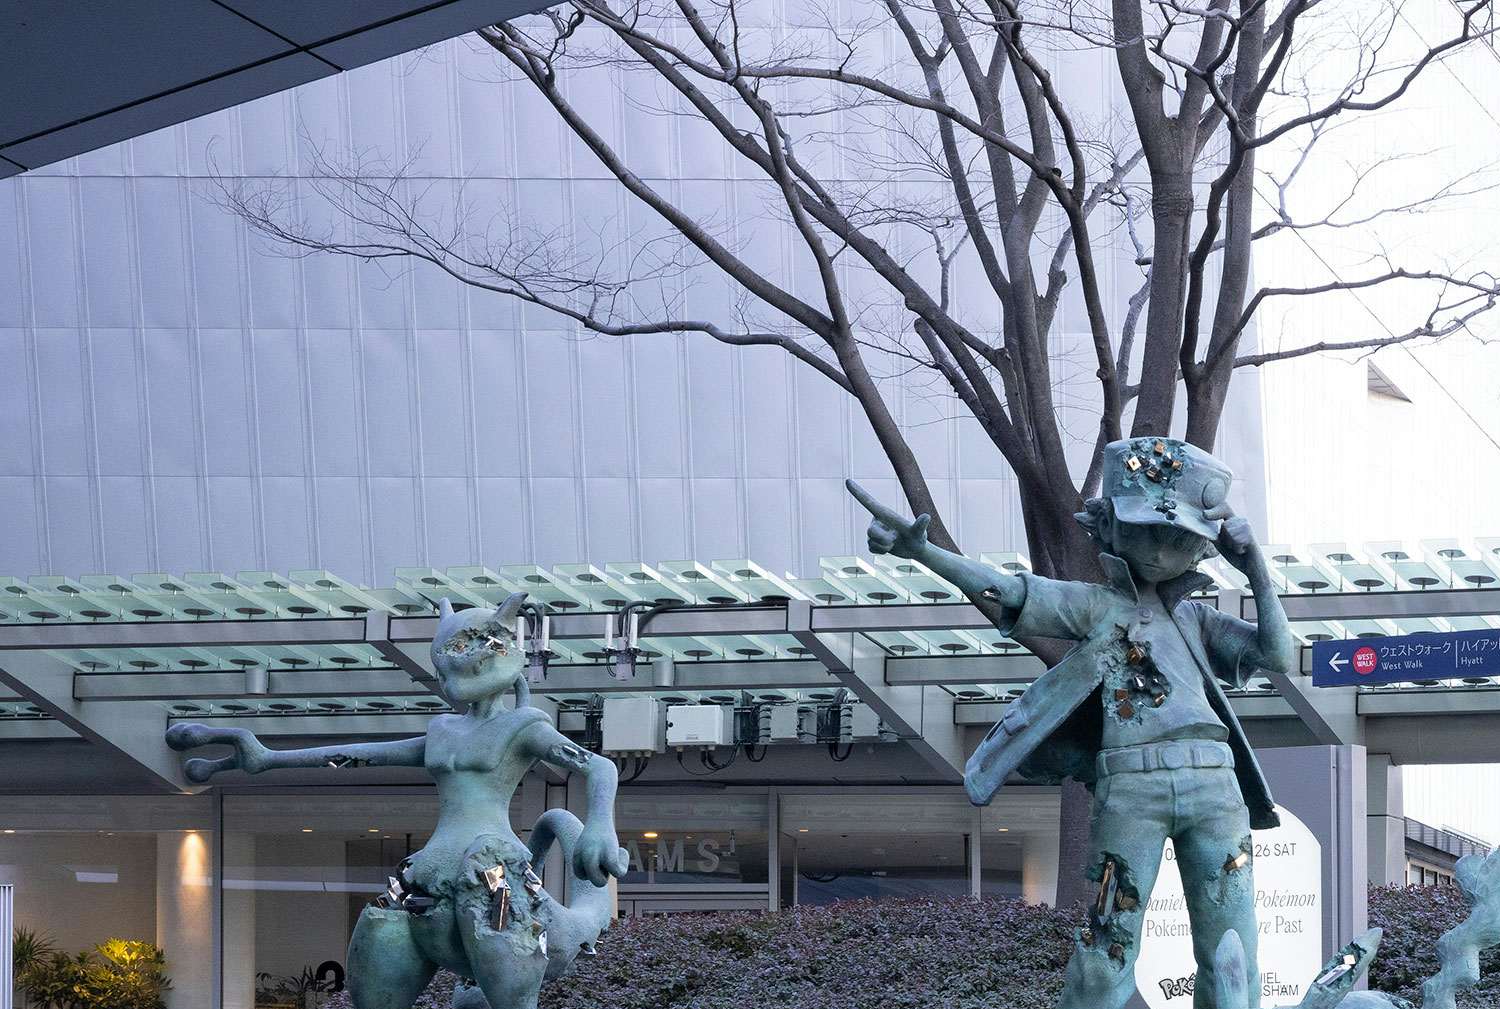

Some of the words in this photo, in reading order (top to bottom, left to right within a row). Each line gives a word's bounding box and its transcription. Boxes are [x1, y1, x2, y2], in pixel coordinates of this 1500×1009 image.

[1381, 661, 1402, 670] West
[1404, 660, 1423, 669] Walk
[1461, 656, 1484, 666] Hyatt
[1274, 842, 1297, 856] SAT
[1254, 888, 1316, 908] Pokémon
[1275, 915, 1304, 935] Past
